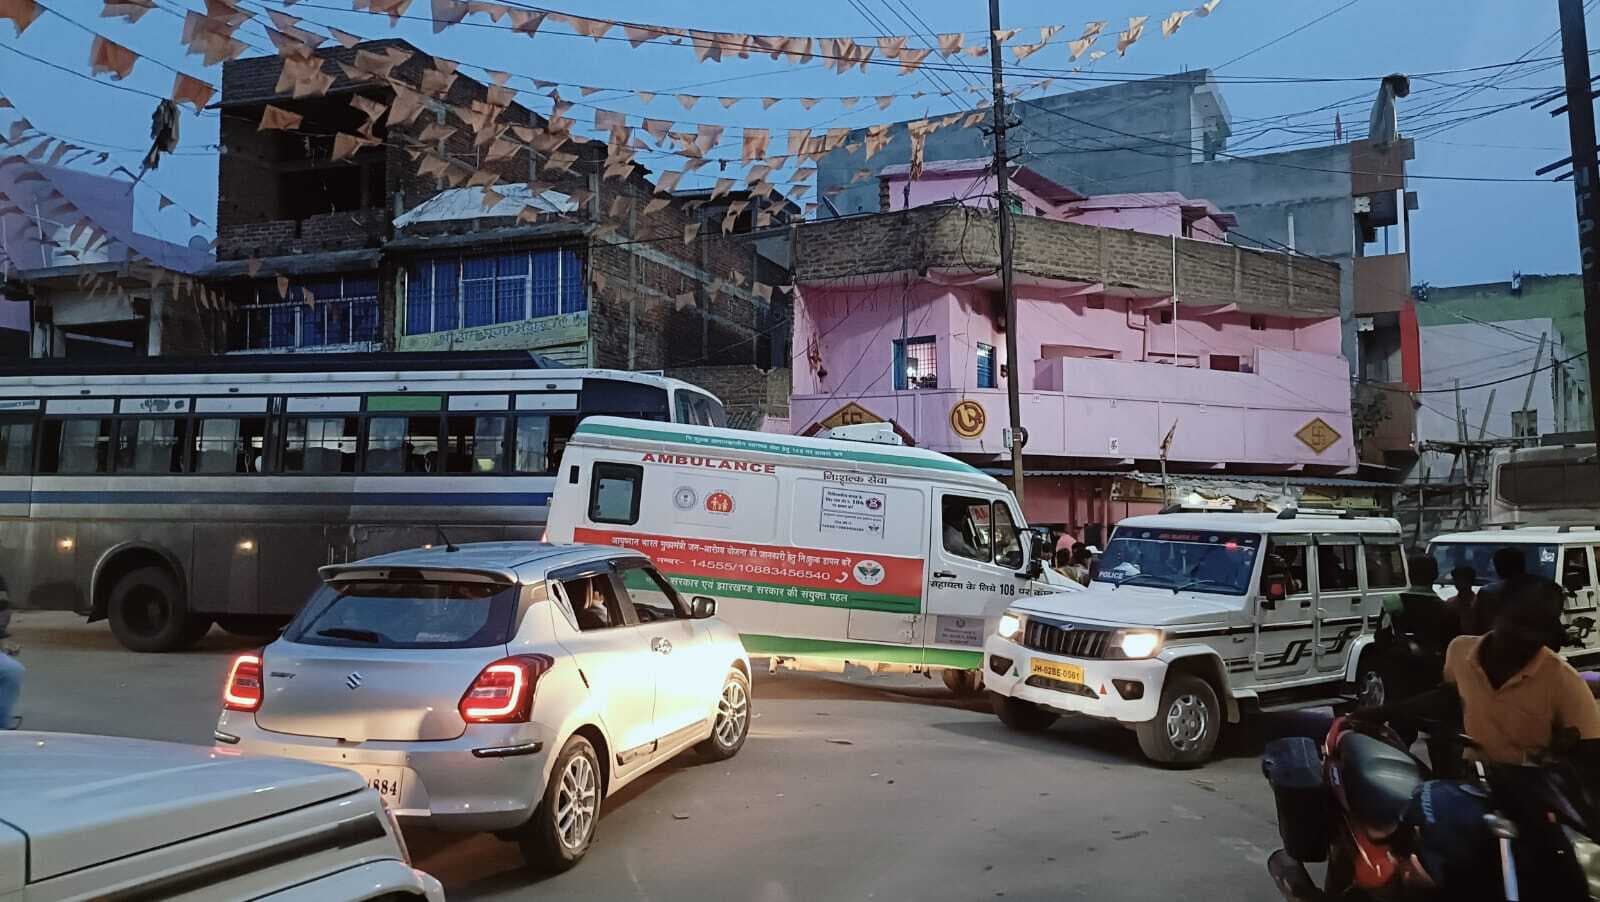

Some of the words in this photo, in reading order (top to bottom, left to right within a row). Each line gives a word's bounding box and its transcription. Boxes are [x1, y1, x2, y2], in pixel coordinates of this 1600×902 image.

[641, 452, 776, 474] AMBULANCE
[867, 474, 888, 484] सेवा
[1099, 570, 1123, 579] POLICE
[670, 577, 698, 588] सरकार
[756, 584, 784, 598] सरकार
[787, 586, 798, 598] की
[802, 588, 826, 602] संयुक्त
[830, 592, 848, 602] पहल
[929, 580, 963, 590] सहायता
[966, 580, 976, 590] के
[979, 582, 996, 592] लिये
[1000, 584, 1015, 596] 108
